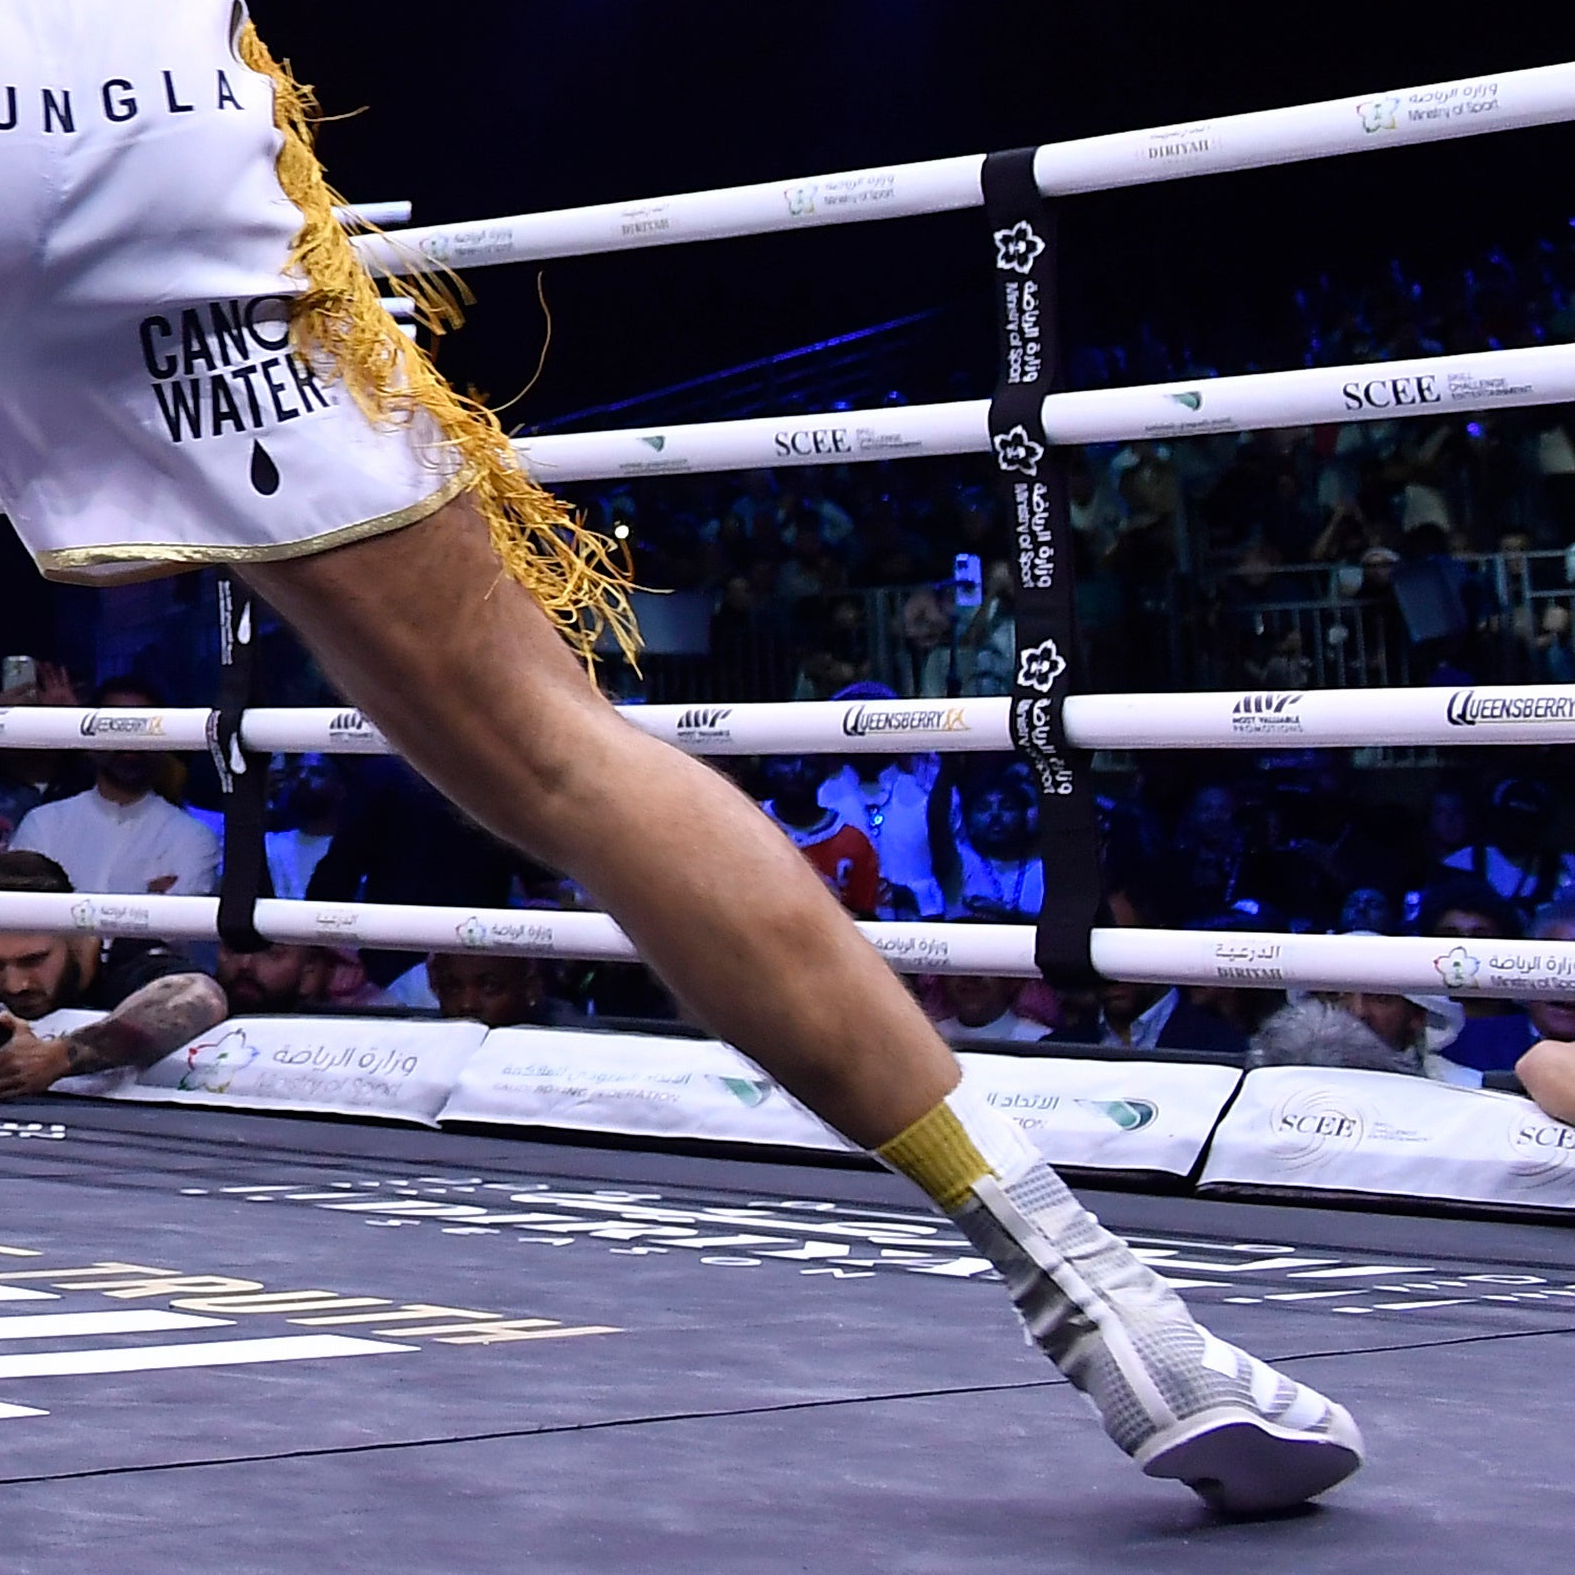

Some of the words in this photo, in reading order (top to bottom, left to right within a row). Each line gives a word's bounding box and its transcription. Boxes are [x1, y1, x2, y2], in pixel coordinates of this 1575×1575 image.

[1149, 140, 1209, 159] DIRIYAH
[151, 353, 331, 443] WATER
[1342, 375, 1440, 410] SCEE
[775, 428, 851, 457] SCEE
[843, 704, 944, 737] QUEENSBERRY
[1447, 689, 1575, 726] QUEENSBERRY
[1489, 956, 1542, 975] الرياضة
[272, 1045, 354, 1073] الرياضة
[357, 1048, 417, 1077] وزارة
[1279, 1112, 1357, 1138] SCEE
[1516, 1126, 1575, 1150] SCE
